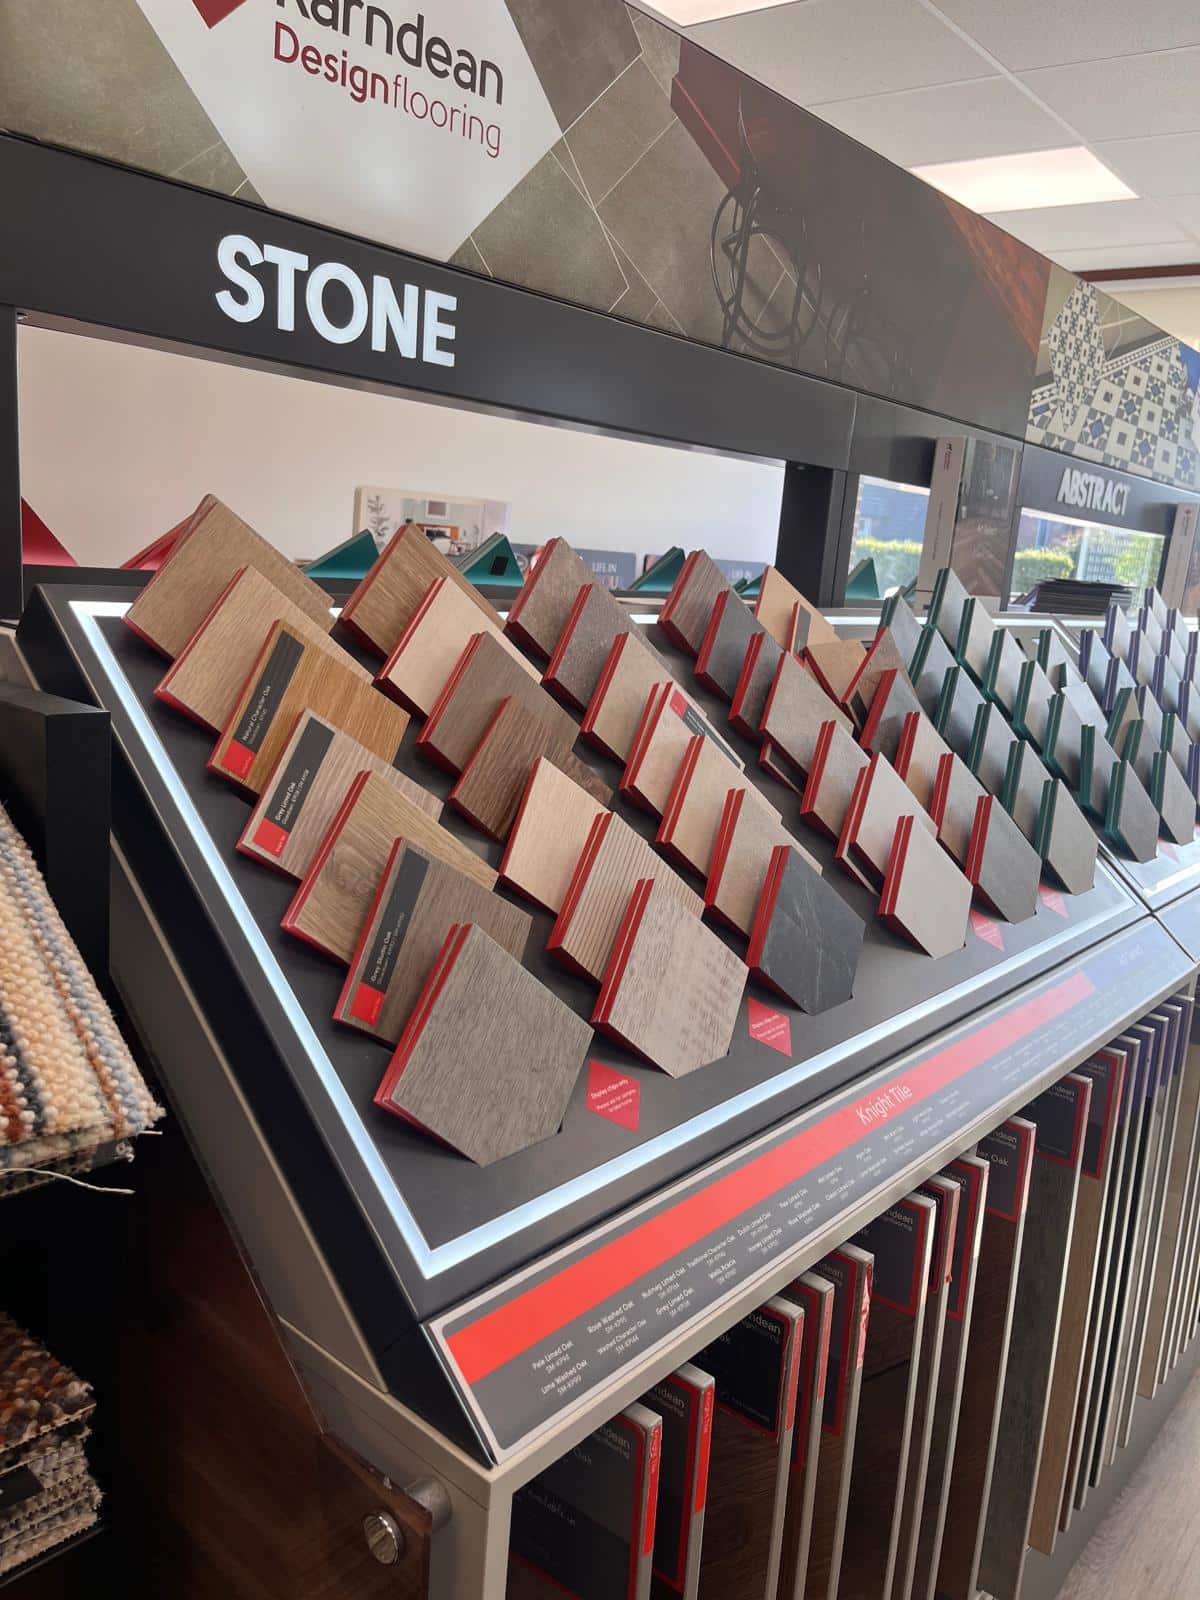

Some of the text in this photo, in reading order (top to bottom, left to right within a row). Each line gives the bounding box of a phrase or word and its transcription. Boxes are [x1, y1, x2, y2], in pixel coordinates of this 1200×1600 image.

[276, 0, 503, 105] arndean
[215, 234, 457, 368] STONE
[1056, 467, 1131, 516] ABSTRACT
[275, 807, 286, 821] Grey
[856, 1094, 895, 1126] Knight
[888, 1084, 913, 1104] Tile
[990, 1153, 1009, 1168] Oak
[561, 1339, 575, 1352] Oak
[576, 1359, 589, 1372] Oak
